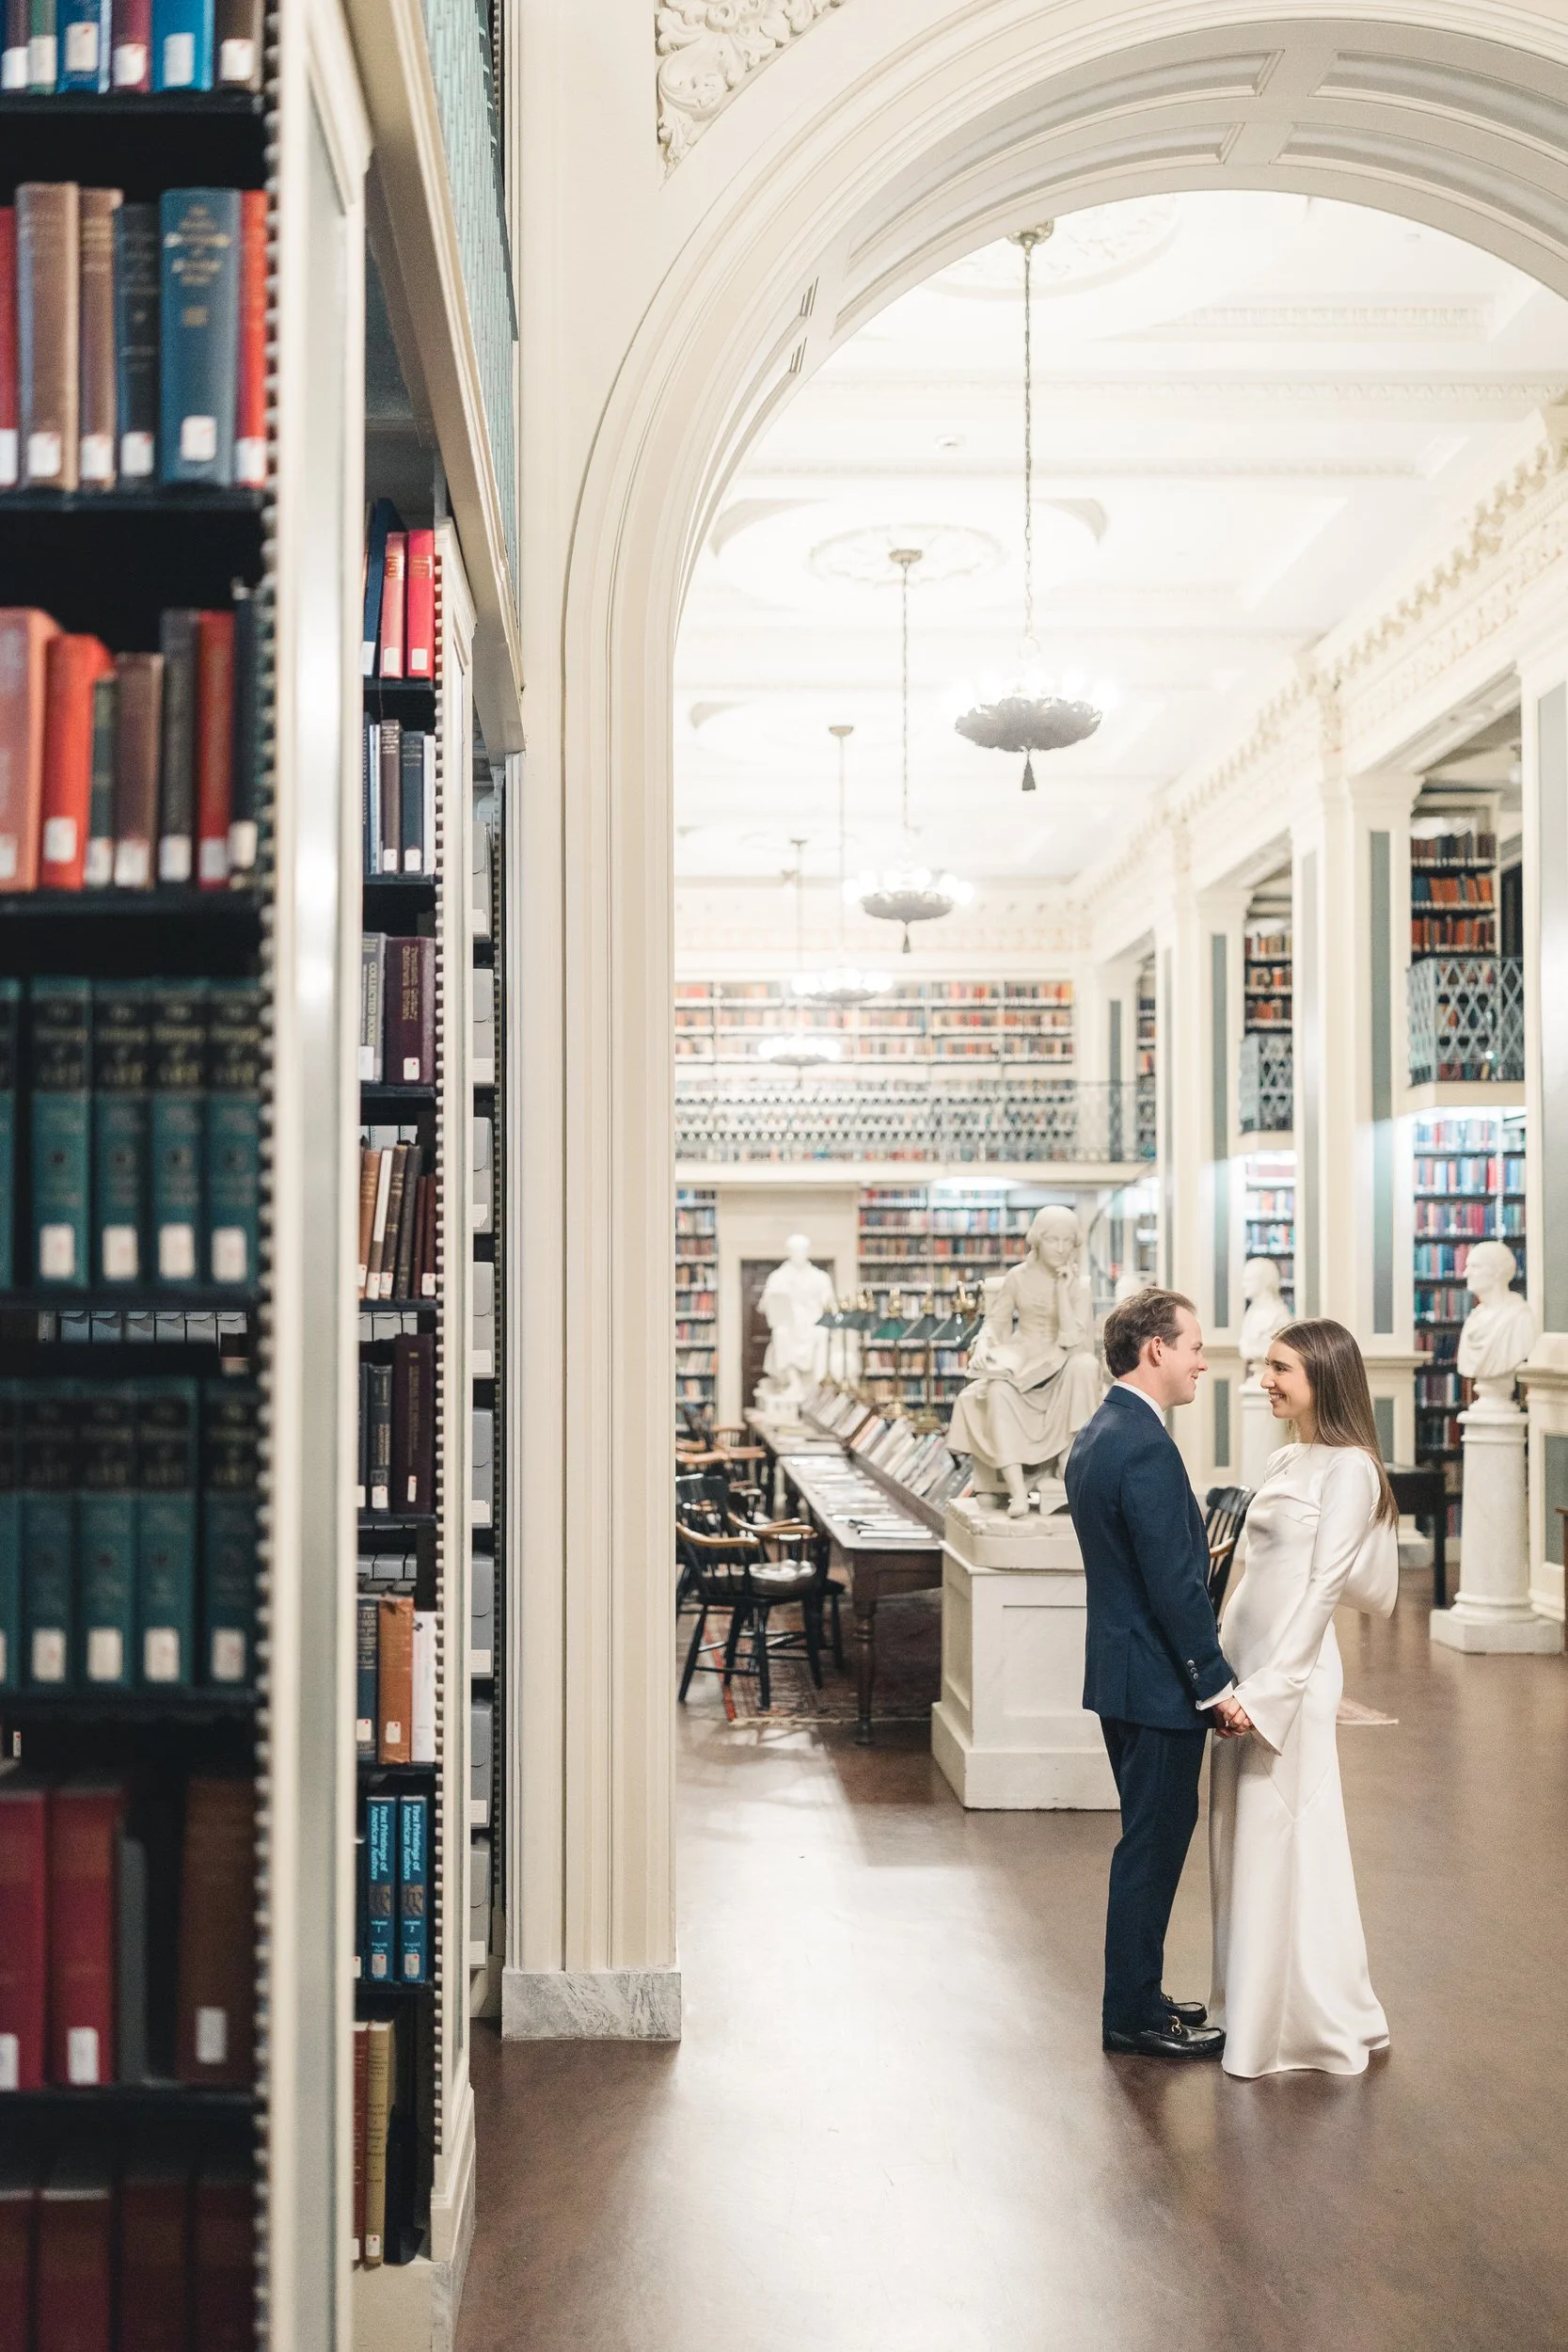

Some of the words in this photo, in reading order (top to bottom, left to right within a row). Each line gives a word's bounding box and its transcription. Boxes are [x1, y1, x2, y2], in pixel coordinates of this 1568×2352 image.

[368, 961, 377, 1015] COLLECTED
[367, 1015, 376, 1045] BOOKS
[413, 1805, 421, 1823] First
[378, 1823, 388, 1861] Printings
[411, 1823, 421, 1861] Printings
[379, 1861, 388, 1871] of
[412, 1861, 421, 1871] of
